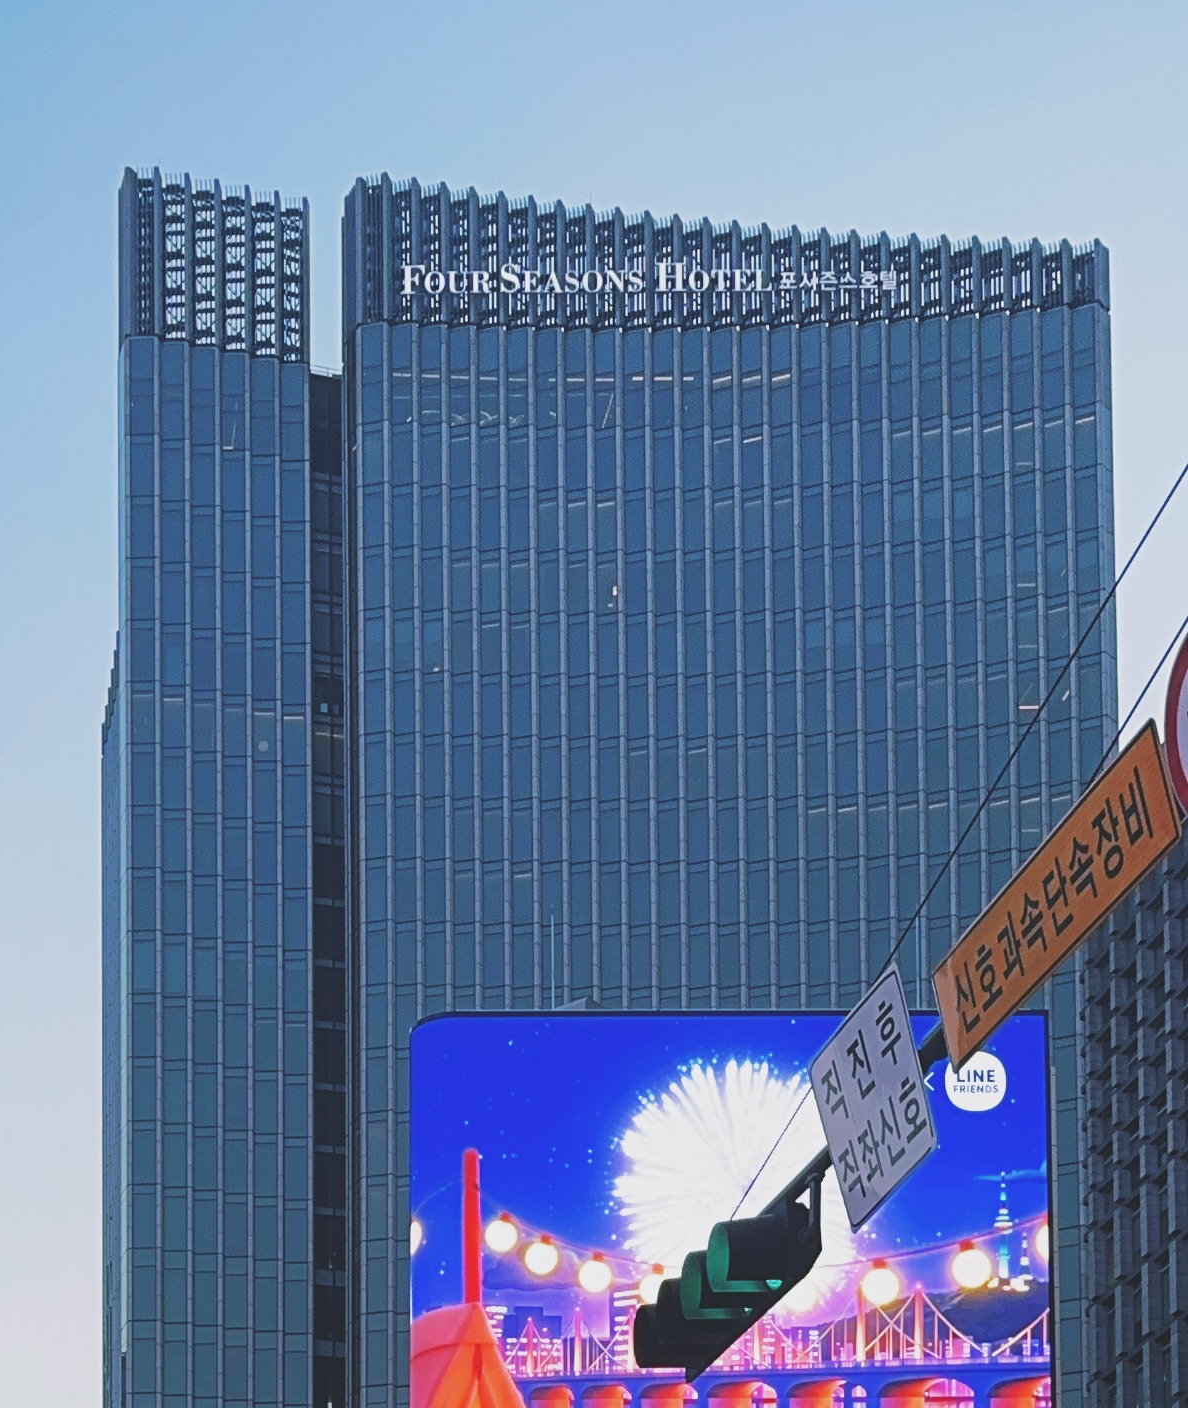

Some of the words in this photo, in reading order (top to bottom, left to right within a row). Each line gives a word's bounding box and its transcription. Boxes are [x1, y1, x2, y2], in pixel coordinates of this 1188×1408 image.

[400, 265, 491, 295] FOUR
[499, 263, 644, 294] SEASONS
[654, 262, 773, 293] HOTEL
[952, 766, 1154, 1034] 신호과속단속장비
[953, 1085, 999, 1093] FRIENDS
[957, 1069, 996, 1082] LINE
[838, 1076, 927, 1198] 직좌신호
